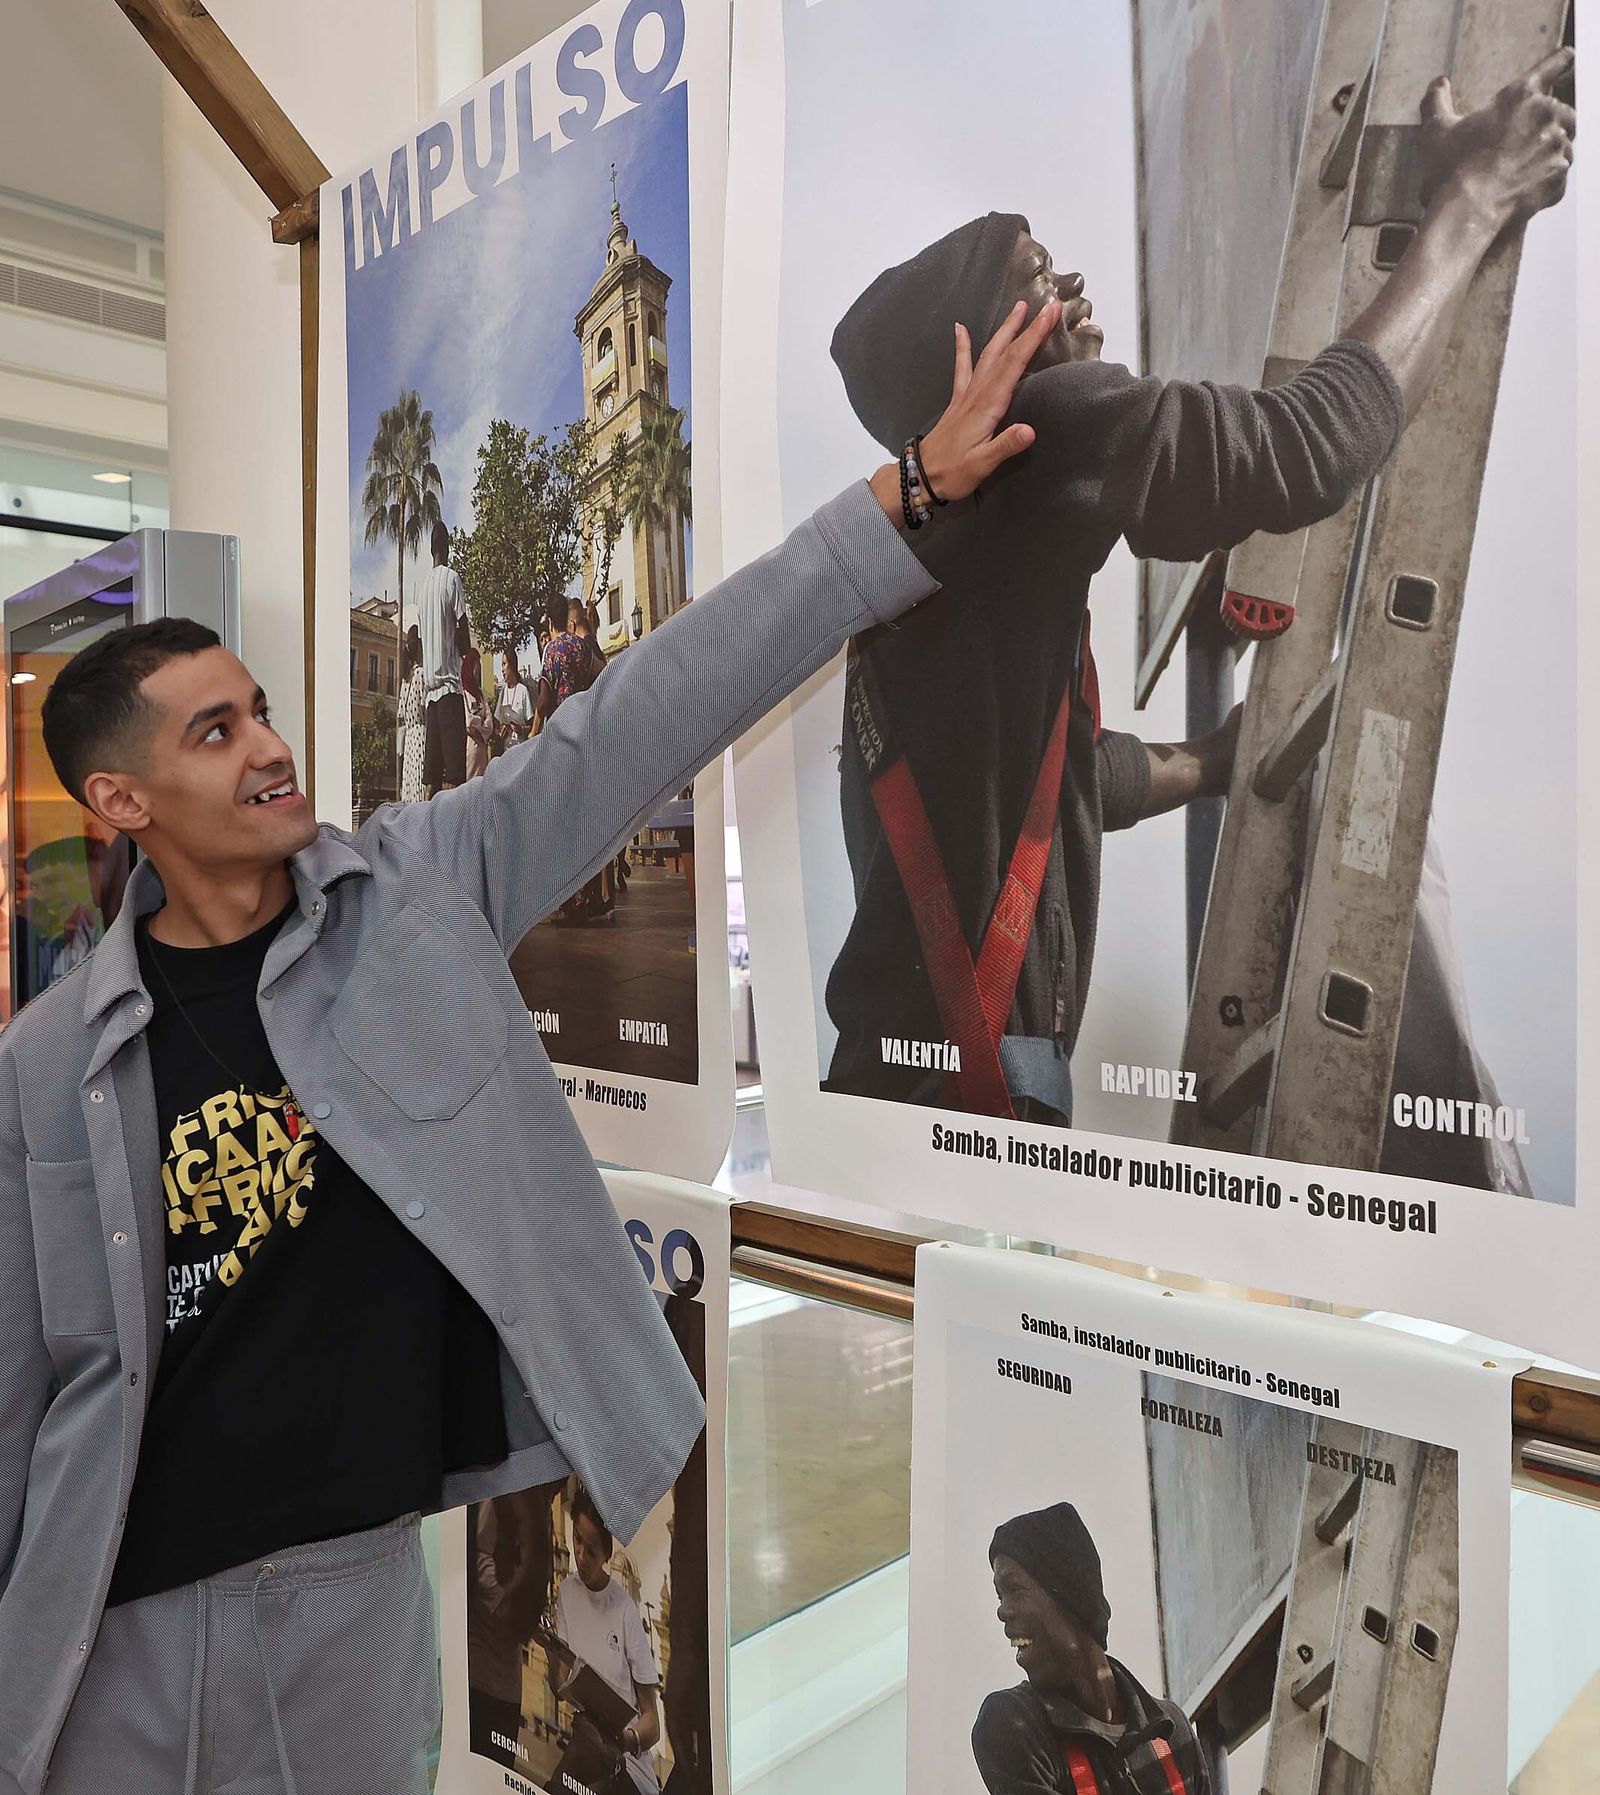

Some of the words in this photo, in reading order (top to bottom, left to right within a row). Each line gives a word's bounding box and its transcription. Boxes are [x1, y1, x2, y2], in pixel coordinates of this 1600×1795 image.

[341, 0, 688, 272] IMPULSO
[881, 1037, 962, 1073] VALENTÍA
[558, 1076, 577, 1098] ral
[585, 1078, 647, 1112] Marruecos
[1100, 1062, 1198, 1103] RAPIDEZ
[1393, 1093, 1530, 1145] CONTROL
[931, 1123, 1002, 1164] Samba,
[1007, 1136, 1123, 1182] instalador
[1128, 1159, 1282, 1210] publicitario
[1307, 1183, 1437, 1235] Senegal
[997, 1357, 1073, 1396] SEGURIDAD
[1020, 1312, 1072, 1344] Samba,
[1074, 1325, 1151, 1362] instalador
[1154, 1347, 1251, 1387] publicitario
[1266, 1372, 1341, 1409] Senegal
[1140, 1396, 1223, 1438] FORTALEZA
[1306, 1441, 1397, 1486] DESTREZA
